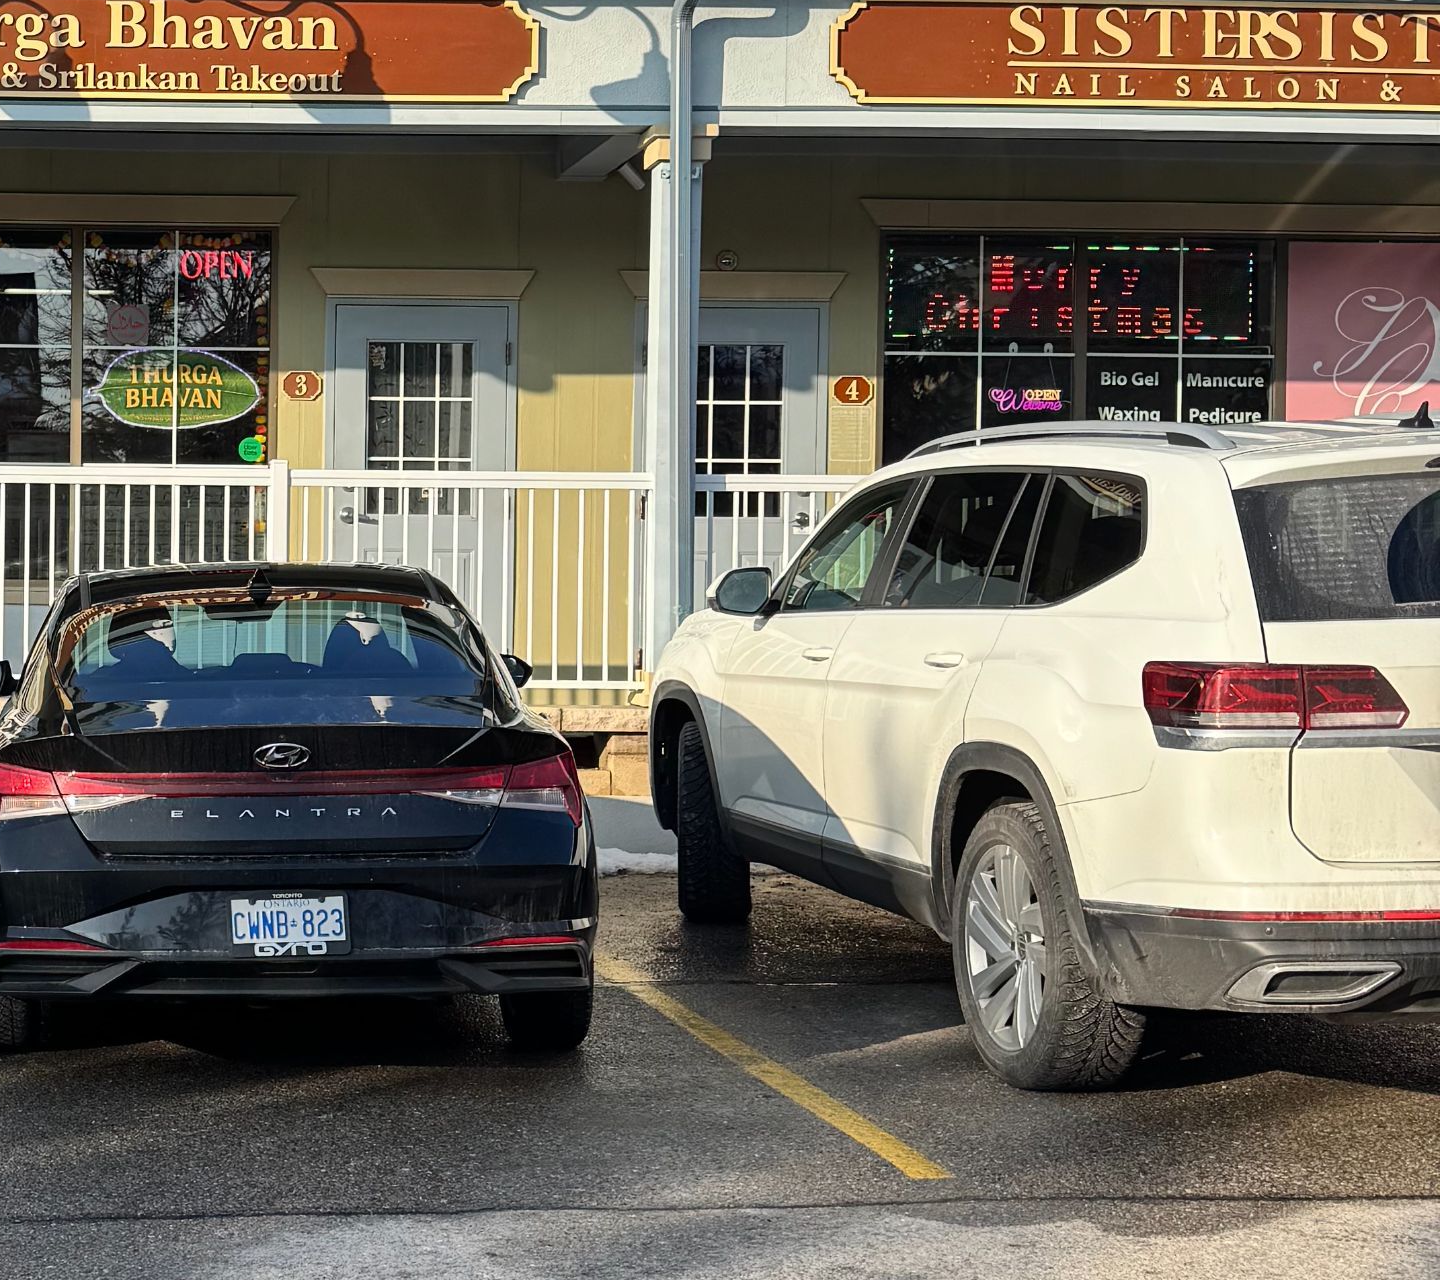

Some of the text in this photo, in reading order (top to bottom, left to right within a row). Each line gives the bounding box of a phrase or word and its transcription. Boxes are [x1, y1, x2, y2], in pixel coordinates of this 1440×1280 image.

[105, 0, 339, 51] Bhavan
[0, 62, 27, 89] &
[38, 62, 200, 91] Srilankan
[210, 65, 343, 93] Takeout
[1014, 72, 1403, 102] NAIL SALON &
[180, 250, 253, 280] OPEN
[129, 364, 223, 385] THURGA
[295, 374, 309, 396] 3
[1100, 372, 1160, 387] Bio Gel
[1186, 373, 1265, 388] Manicure
[126, 387, 222, 409] BHAVAN
[845, 379, 860, 401] 4
[1024, 389, 1061, 401] OPEN
[1098, 406, 1161, 422] Waxing
[1188, 408, 1262, 424] Pedicure
[170, 807, 397, 818] ELANTRA
[233, 908, 344, 939] CWNB 823
